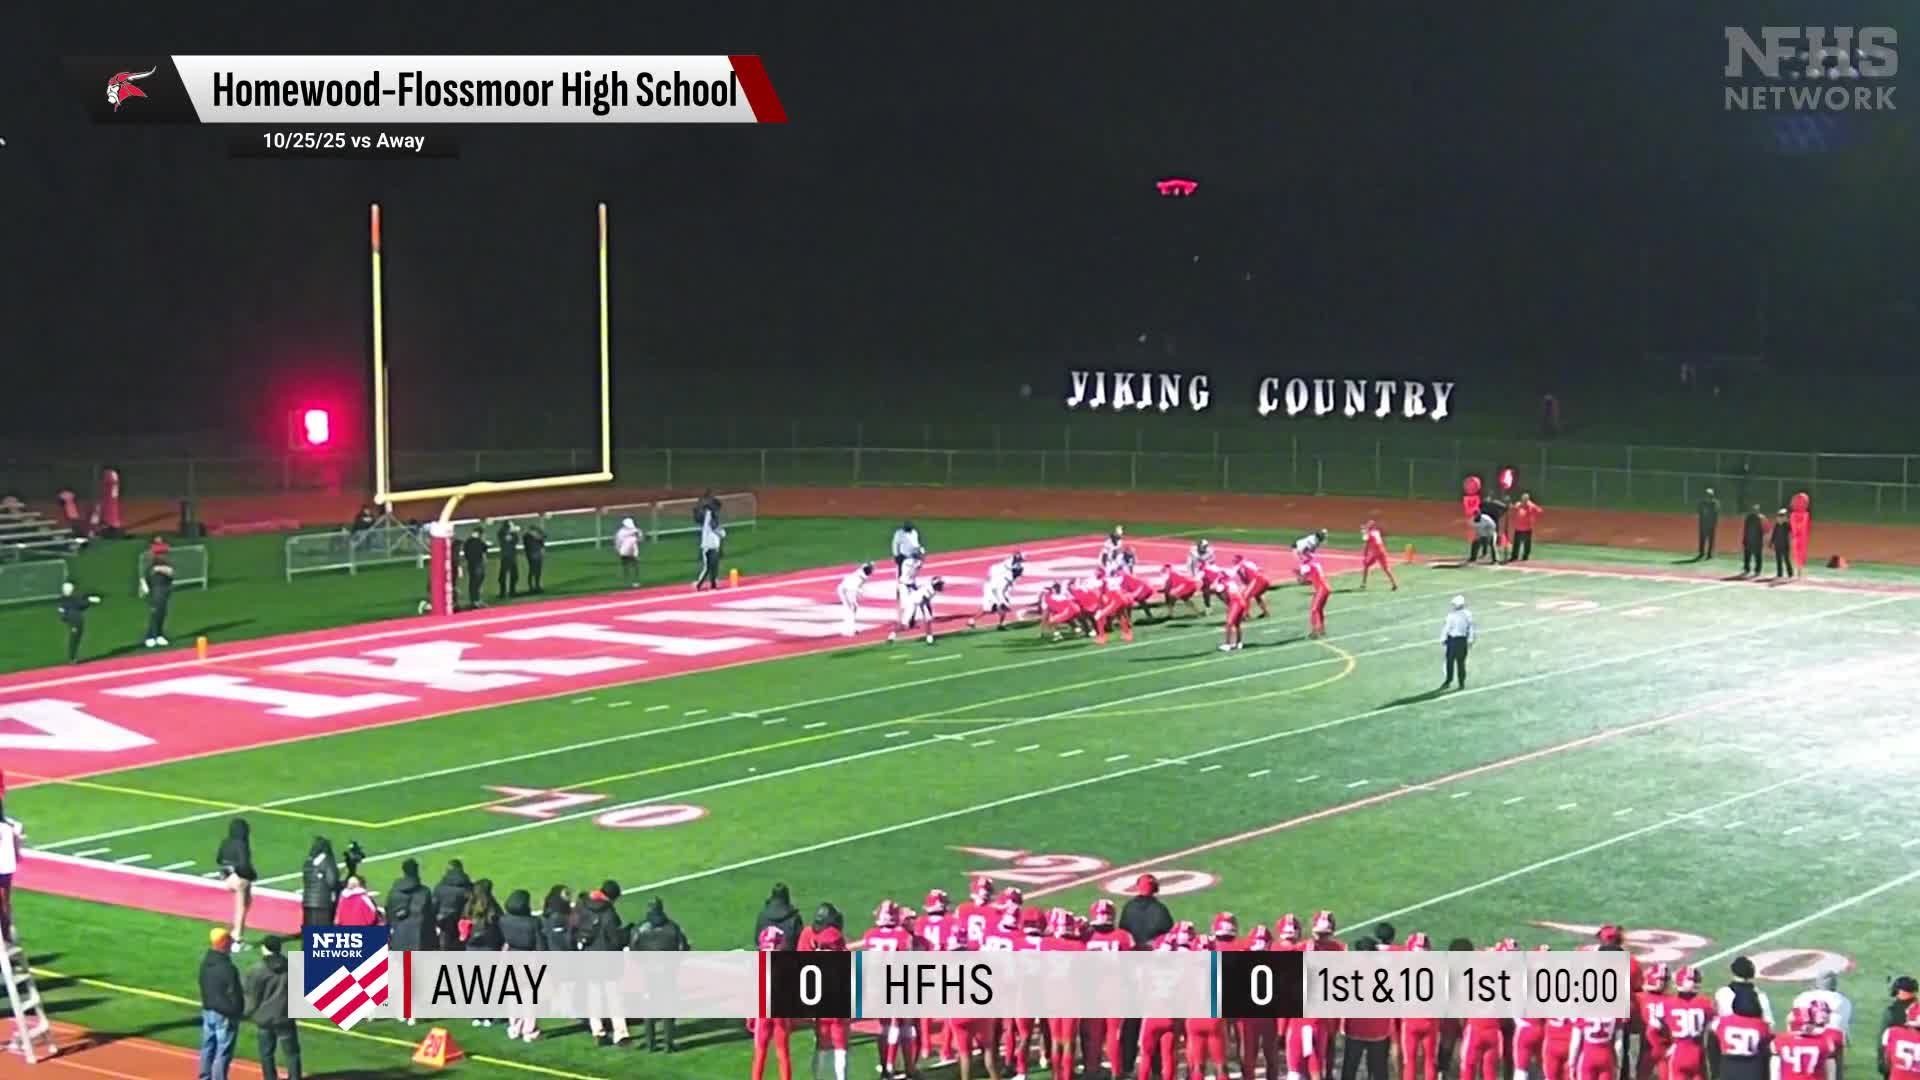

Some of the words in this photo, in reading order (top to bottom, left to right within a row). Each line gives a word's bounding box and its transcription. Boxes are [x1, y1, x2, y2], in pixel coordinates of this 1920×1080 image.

[1067, 371, 1210, 412] VIKING
[1258, 377, 1454, 421] COUNTRY
[1671, 1008, 1705, 1039] 30
[1724, 1026, 1760, 1056] 50
[1781, 1045, 1820, 1075] 47
